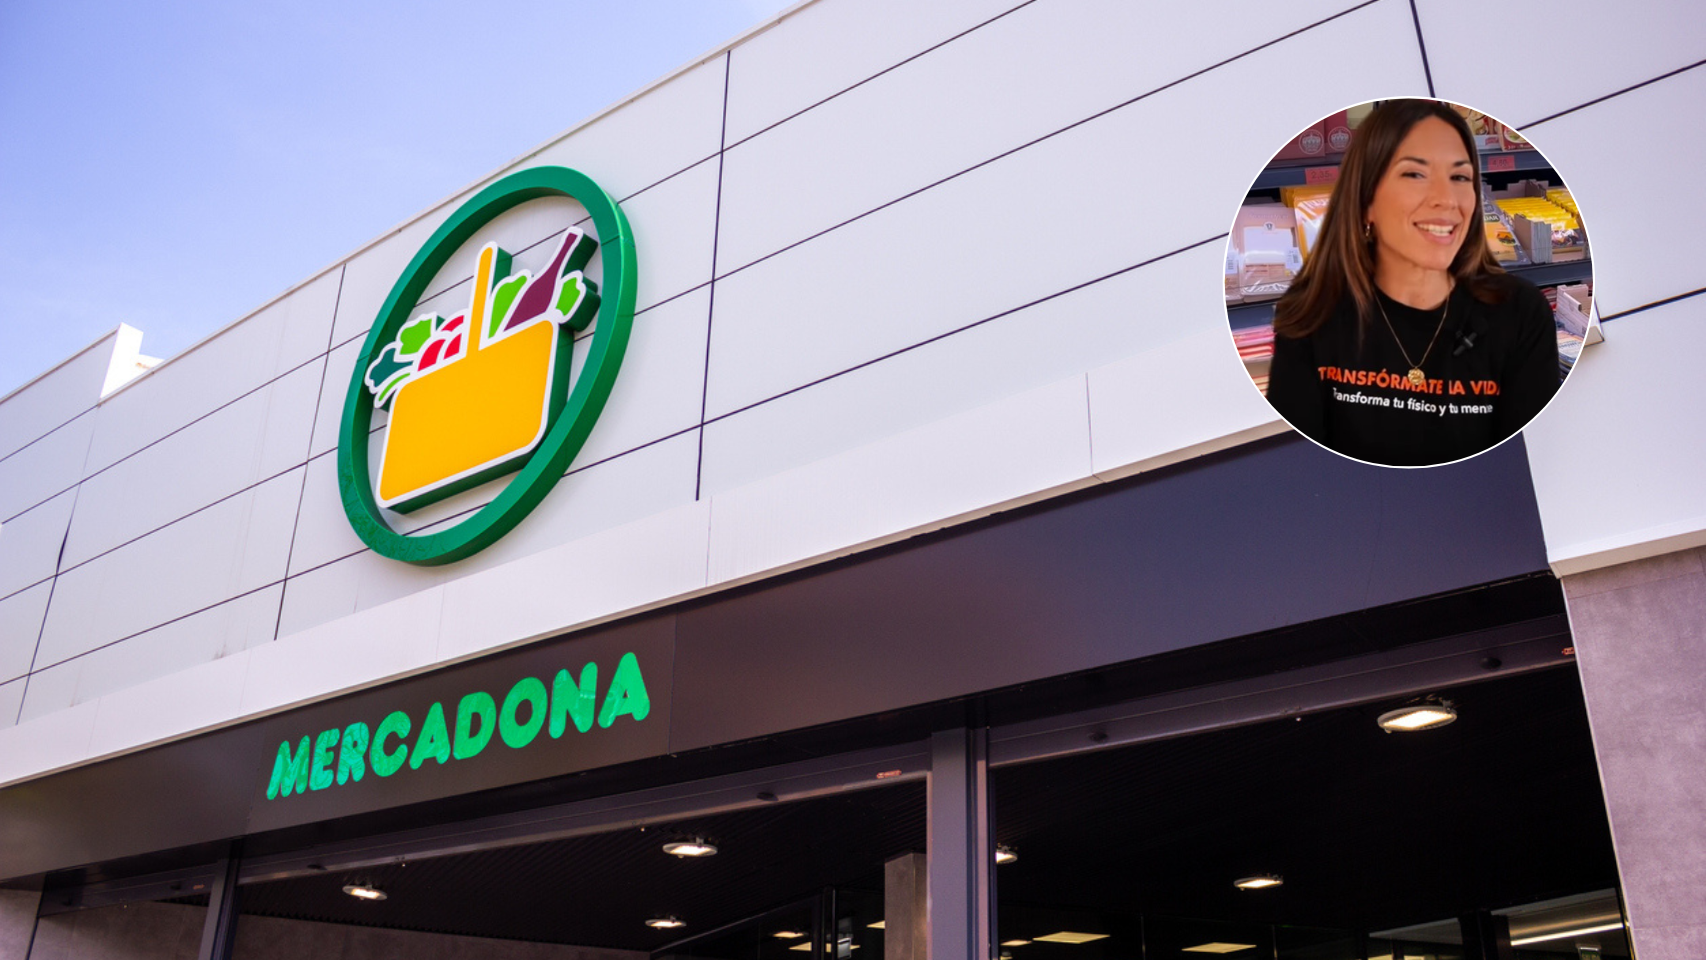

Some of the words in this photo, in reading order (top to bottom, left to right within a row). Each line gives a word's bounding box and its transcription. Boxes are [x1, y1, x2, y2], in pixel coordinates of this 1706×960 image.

[1318, 366, 1443, 394] TRANSFÓRMATE
[1448, 380, 1466, 395] LA
[1393, 397, 1404, 409] tu
[1407, 397, 1437, 413] físico
[1438, 404, 1447, 417] y
[1448, 402, 1459, 414] tu
[266, 652, 650, 800] MERCADONA
